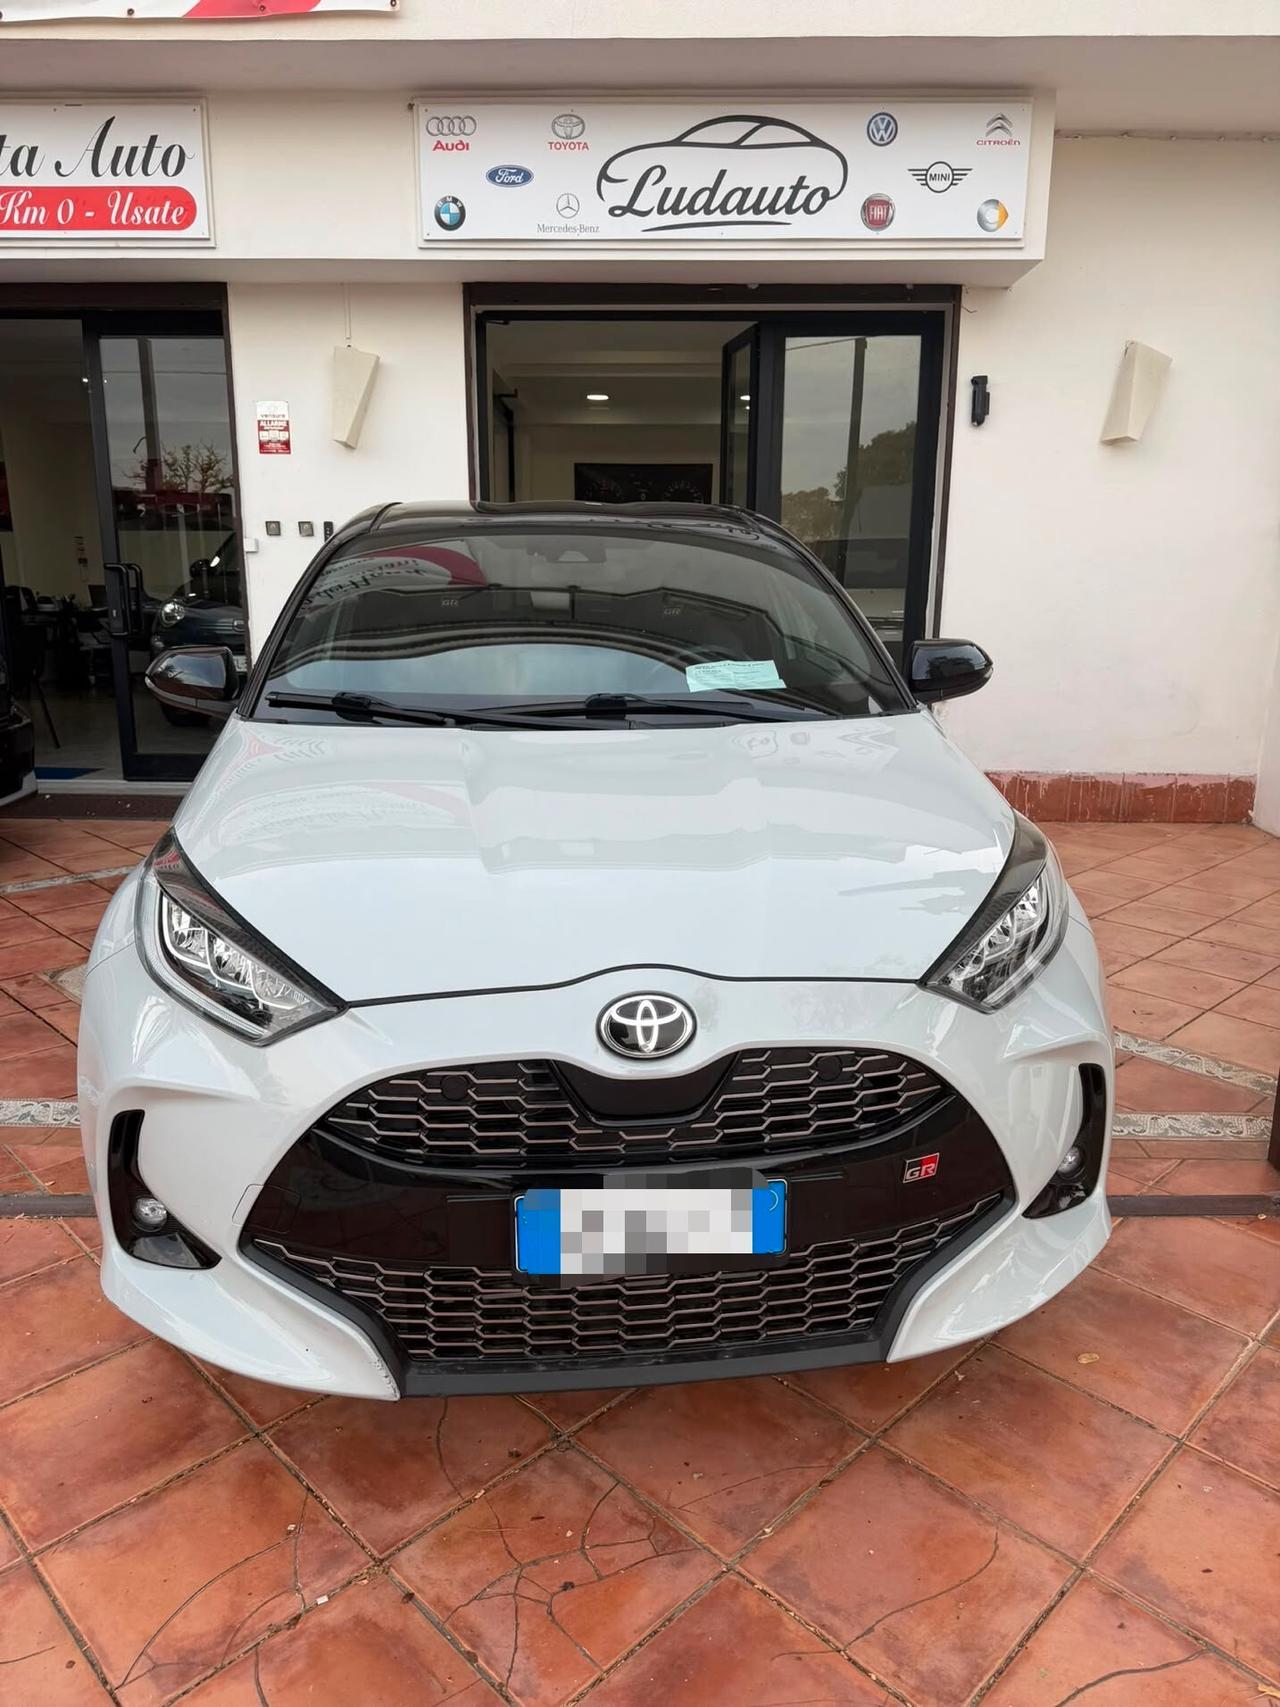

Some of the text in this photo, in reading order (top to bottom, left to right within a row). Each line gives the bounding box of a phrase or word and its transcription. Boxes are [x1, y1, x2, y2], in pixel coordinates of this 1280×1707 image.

[54, 115, 196, 178] Auto
[432, 140, 470, 151] Audi
[548, 141, 590, 151] TOYOTA
[495, 168, 525, 184] Ford
[928, 173, 950, 182] MINI
[608, 164, 831, 218] Ludauto
[0, 190, 49, 225] Km
[57, 198, 75, 225] 0
[107, 190, 188, 225] Usate
[869, 204, 889, 221] FIAT
[536, 223, 600, 233] Mercedes-Benz
[905, 1162, 937, 1180] GR
